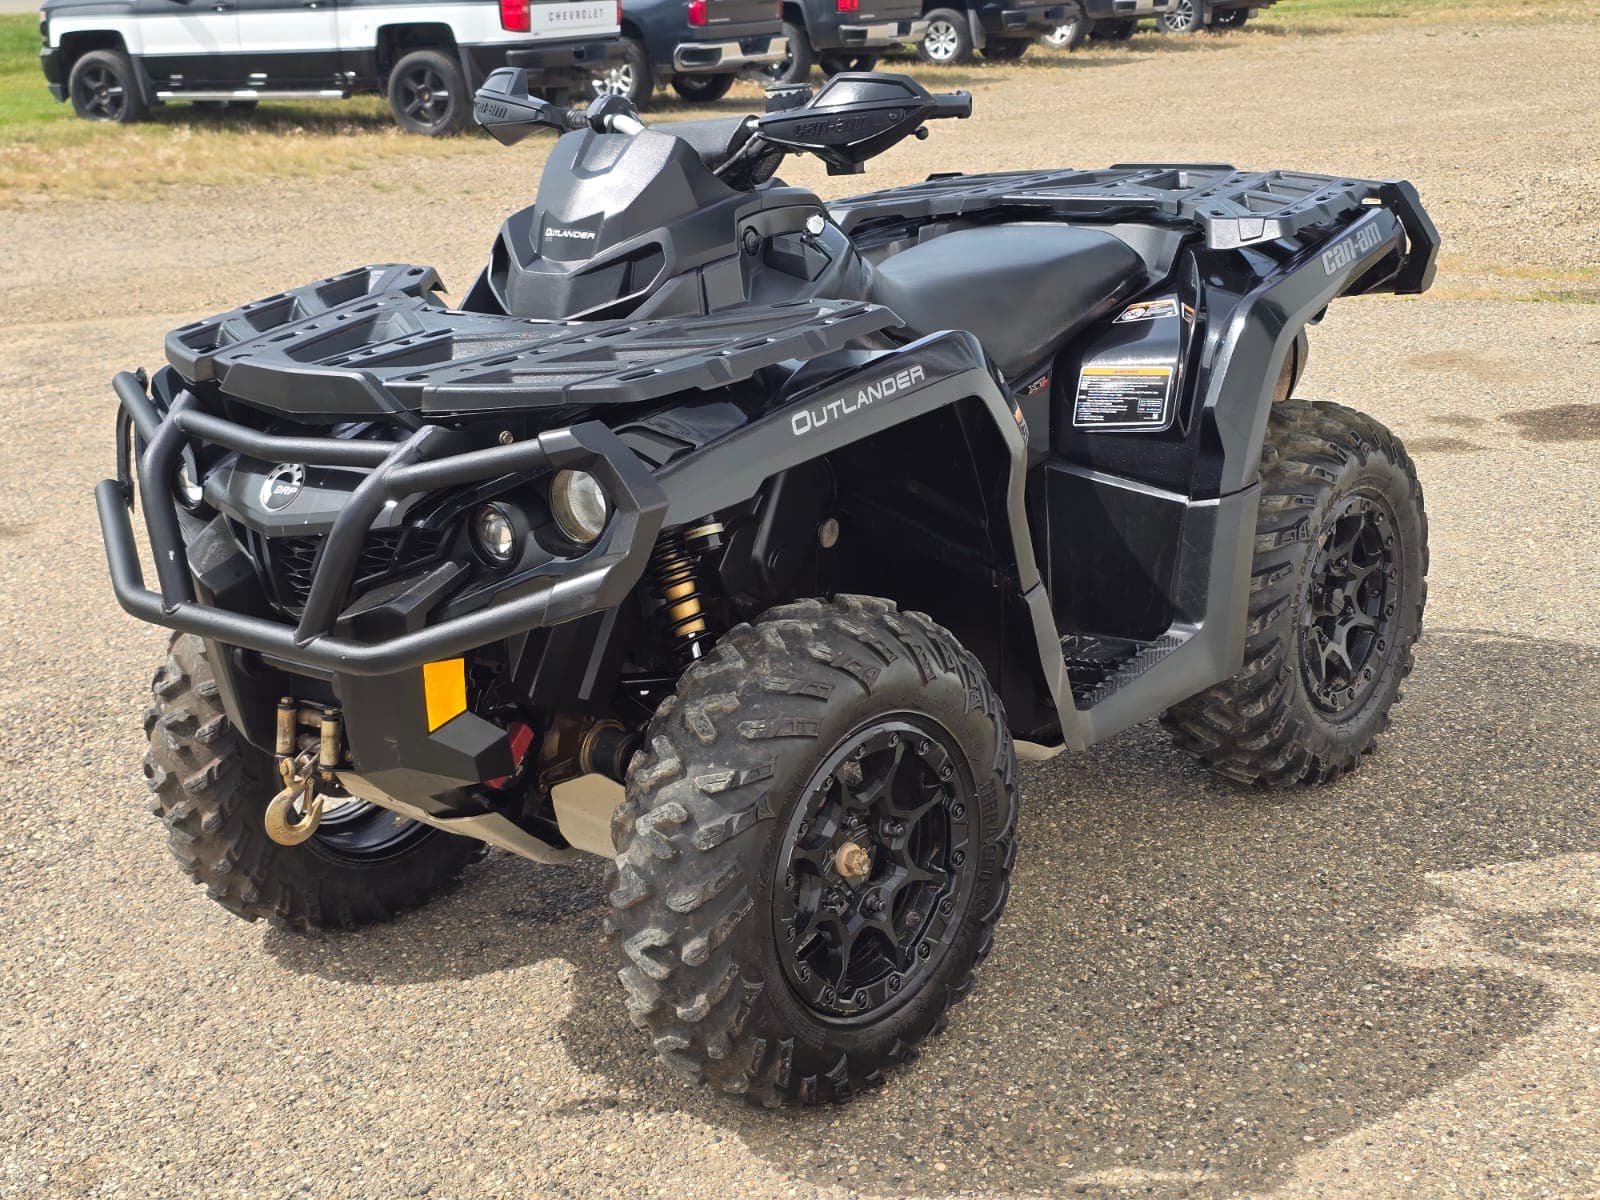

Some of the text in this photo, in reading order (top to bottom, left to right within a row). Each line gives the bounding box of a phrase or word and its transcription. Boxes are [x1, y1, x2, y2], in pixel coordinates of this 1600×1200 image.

[548, 8, 603, 22] CHEVROLET
[545, 227, 596, 240] OUTLANDER
[1321, 222, 1382, 276] can-am
[791, 365, 925, 436] OUTLANDER
